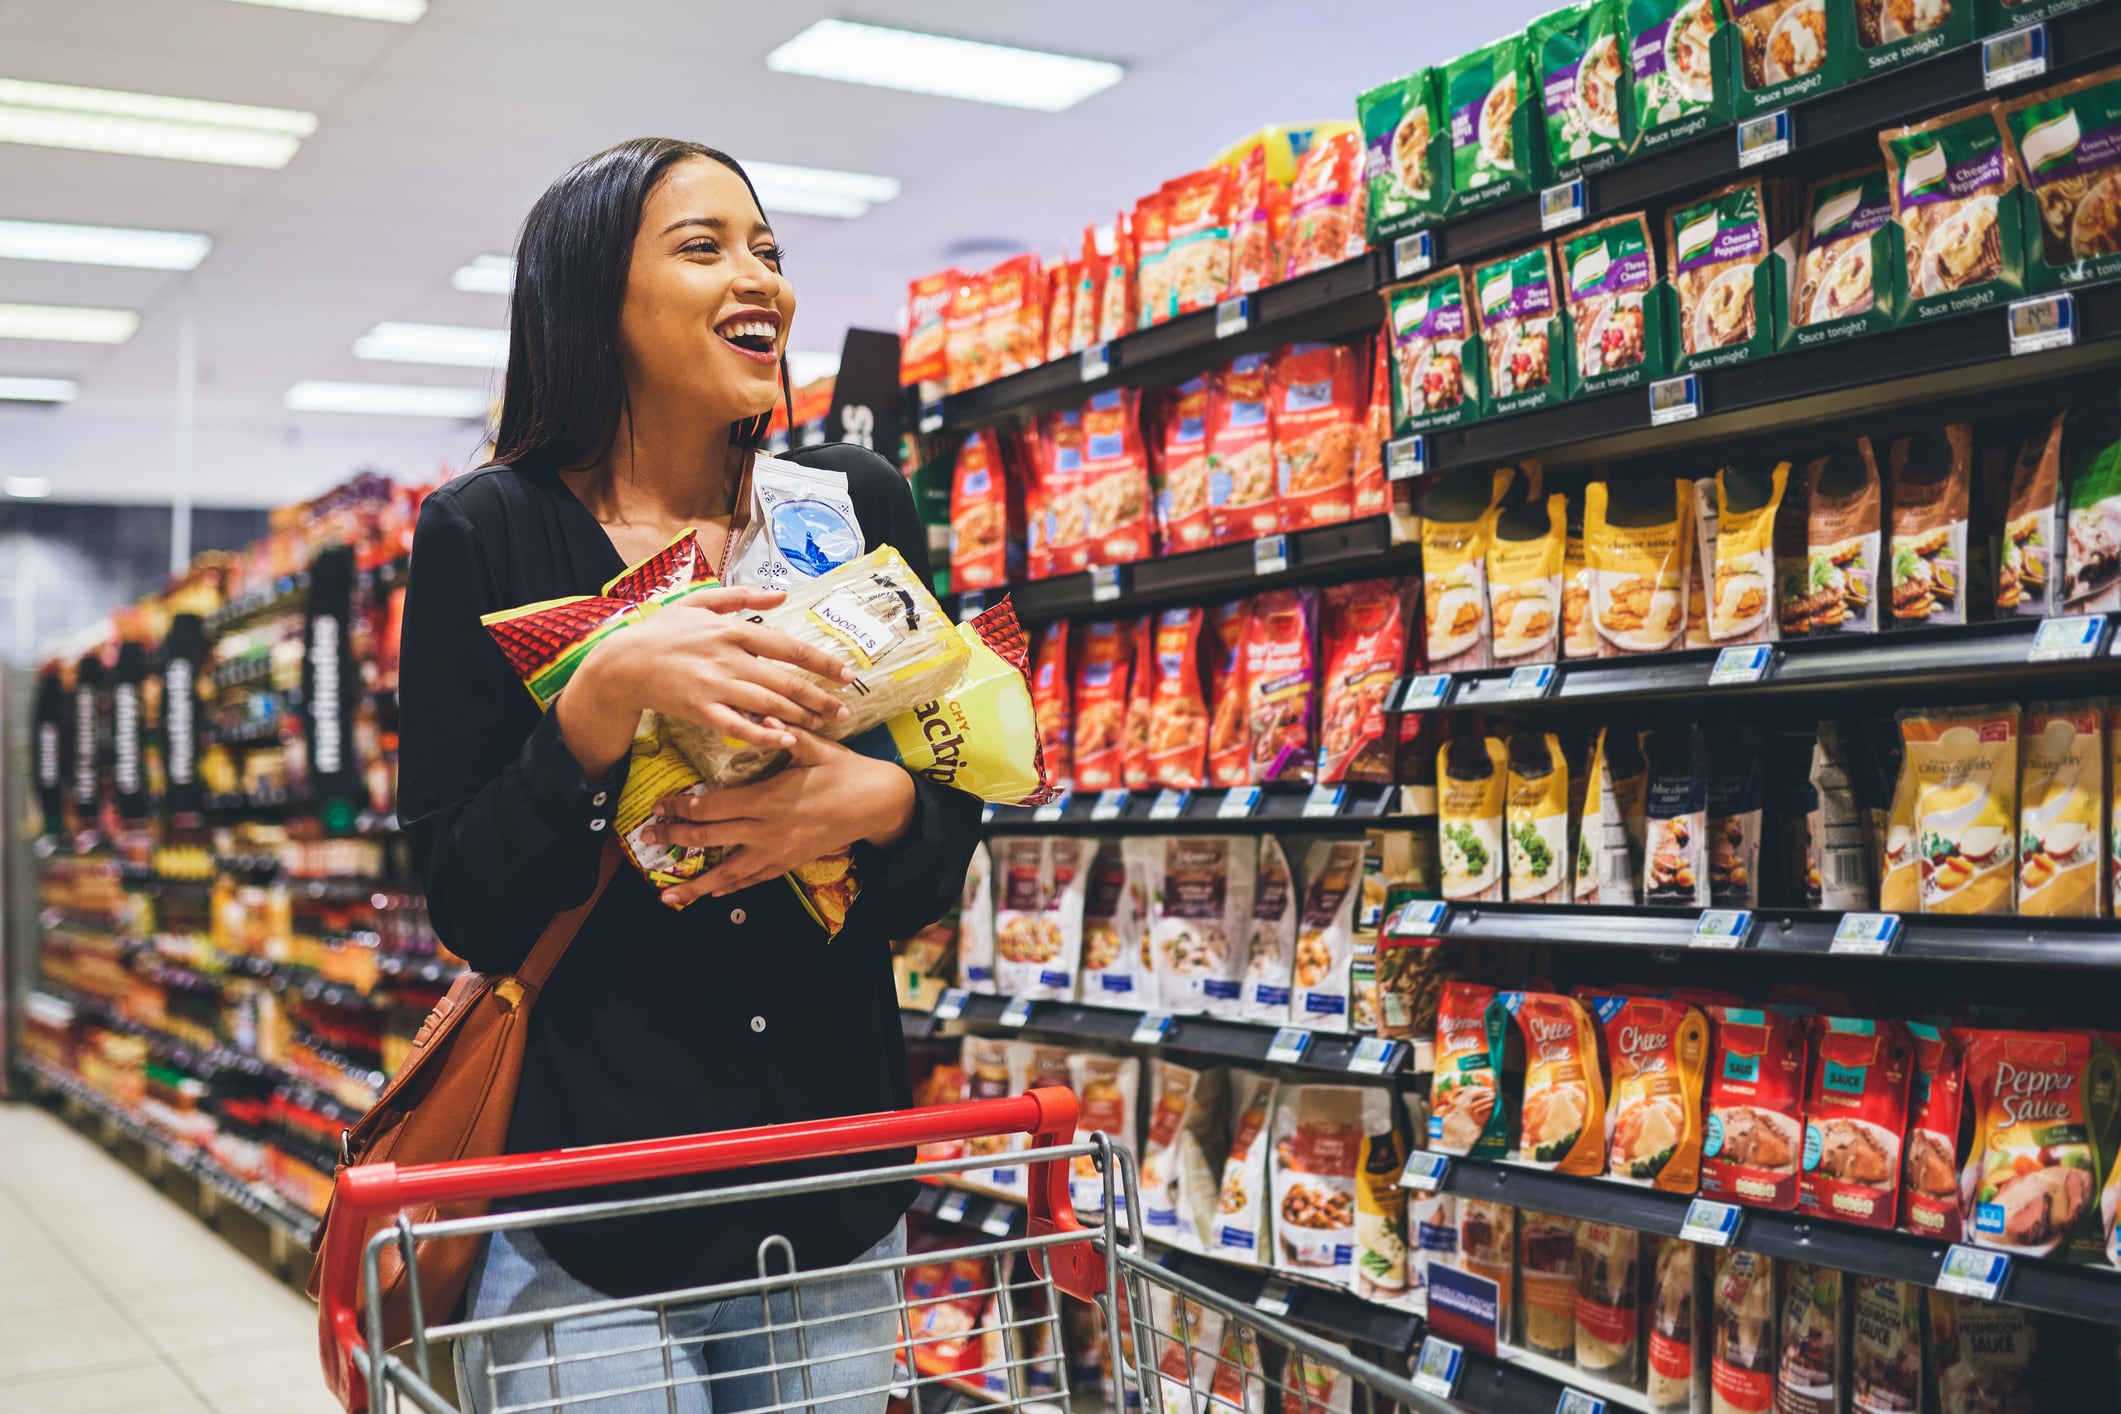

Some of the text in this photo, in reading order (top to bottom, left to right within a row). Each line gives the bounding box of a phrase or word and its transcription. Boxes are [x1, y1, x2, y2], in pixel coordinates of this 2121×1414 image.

[2012, 9, 2045, 27] Sauce
[1868, 34, 1945, 68] Sauce tonight?
[1754, 74, 1822, 106] Sauce tonight?
[1644, 117, 1707, 146] Sauce tonight?
[1559, 154, 1615, 181] Sauce tonight?
[1460, 180, 1511, 206] Sauce tonight?
[1378, 211, 1425, 235] Sauce tonight?
[1714, 240, 1759, 258] Peppercorn
[1722, 233, 1750, 246] Cheese
[1919, 290, 1994, 318] Sauce tonight?
[1798, 320, 1867, 345] Sauce tonight?
[1689, 348, 1749, 371] Sauce tonight?
[1584, 370, 1640, 392] Sauce tonight?
[1497, 393, 1546, 413] Sauce tonight?
[1411, 410, 1461, 429] Sauce tonight?
[822, 607, 877, 649] NOODLES
[949, 700, 971, 731] CHY
[913, 699, 968, 784] achip
[1530, 1018, 1573, 1042] Cheese
[1619, 1026, 1668, 1053] Cheese
[1441, 1032, 1480, 1057] Sauce
[1534, 1042, 1572, 1070] Sauce
[1629, 1053, 1667, 1080] Sauce
[1829, 1072, 1860, 1088] SAUCE
[1994, 1061, 2076, 1098] Pepper
[1997, 1095, 2070, 1129] Sauce
[1859, 1318, 1891, 1347] SAUCE
